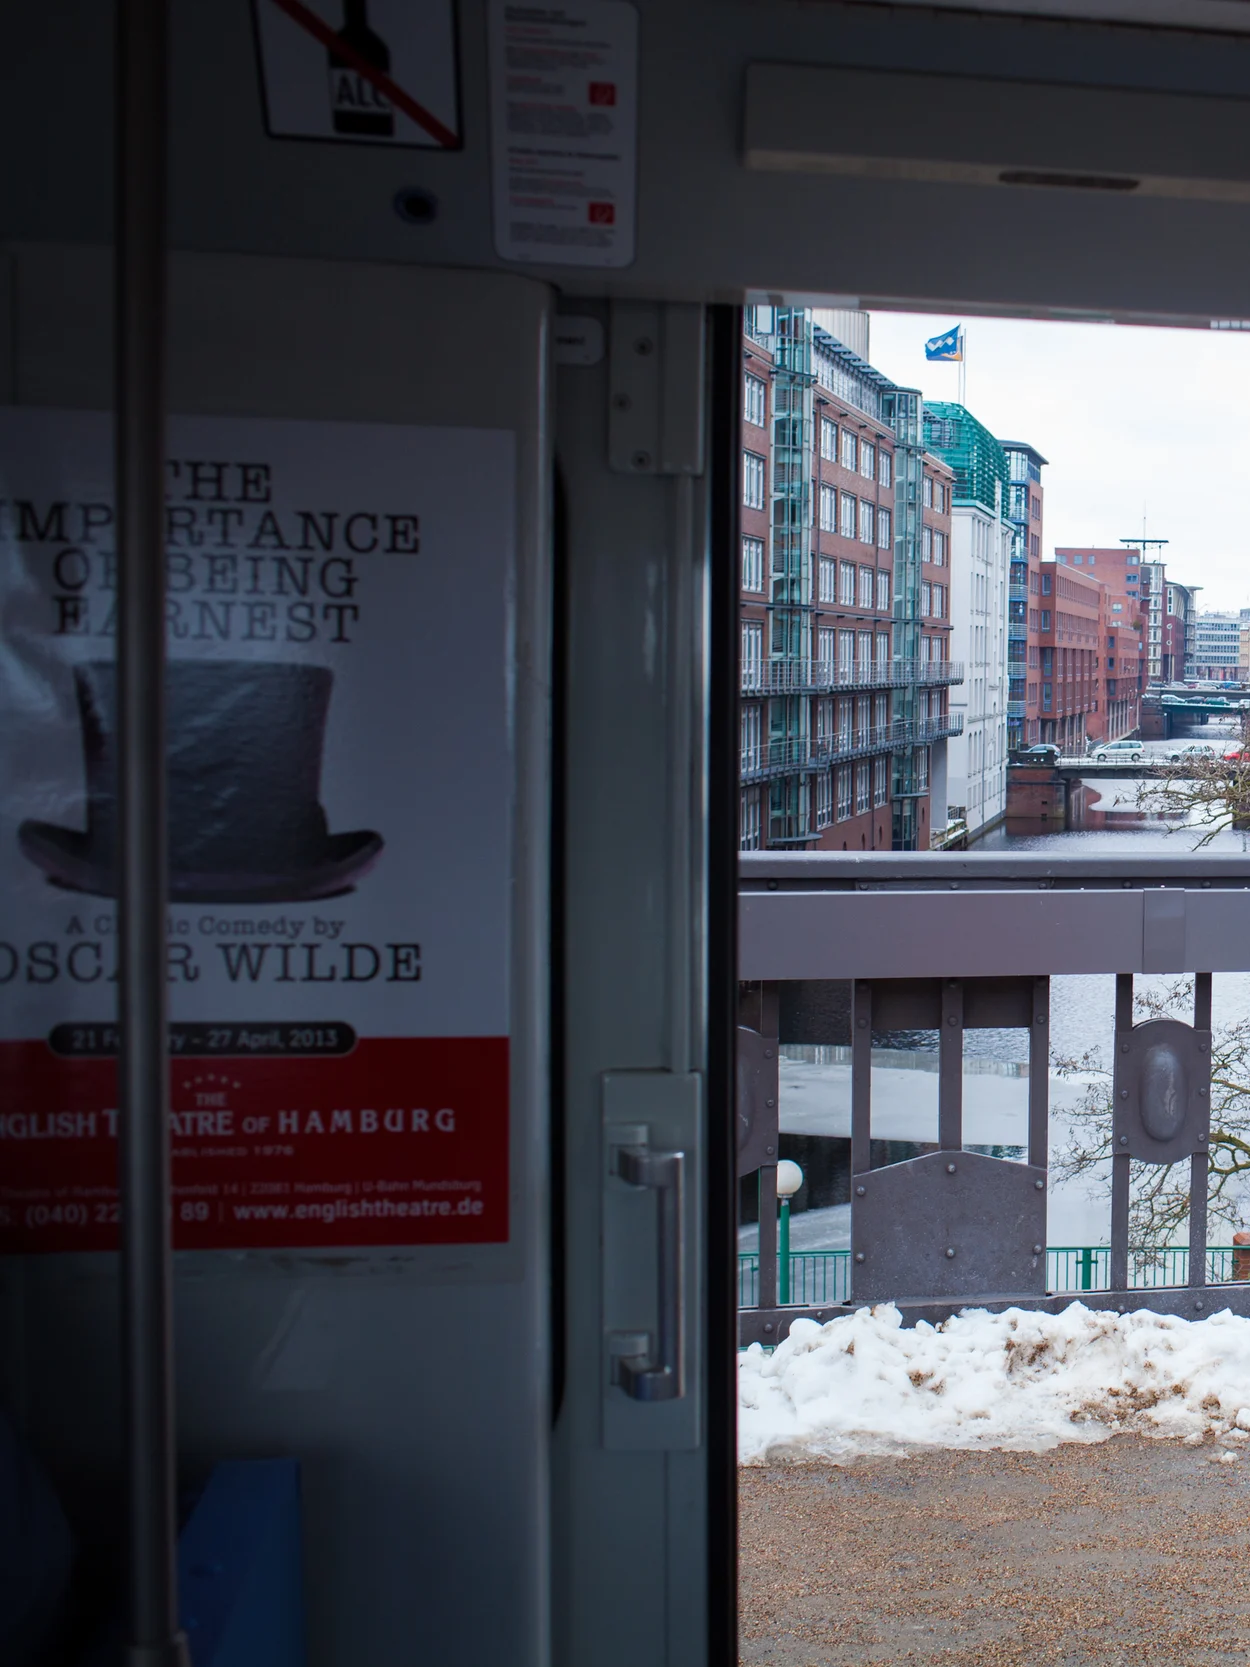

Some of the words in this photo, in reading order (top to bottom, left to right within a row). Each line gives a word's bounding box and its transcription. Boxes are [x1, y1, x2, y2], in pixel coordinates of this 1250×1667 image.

[0, 498, 420, 555] MPRTANCE
[165, 552, 359, 598] BEING
[64, 914, 86, 936] A
[198, 915, 305, 938] Comedy
[313, 915, 346, 938] by
[0, 941, 199, 984] OSCR
[216, 941, 422, 983] WILDE
[207, 1028, 233, 1048] 27
[289, 1028, 338, 1048] 2013
[101, 1108, 236, 1137] TATRE
[276, 1107, 457, 1135] HAMBURG
[232, 1197, 485, 1224] www.englishtheatre.de
